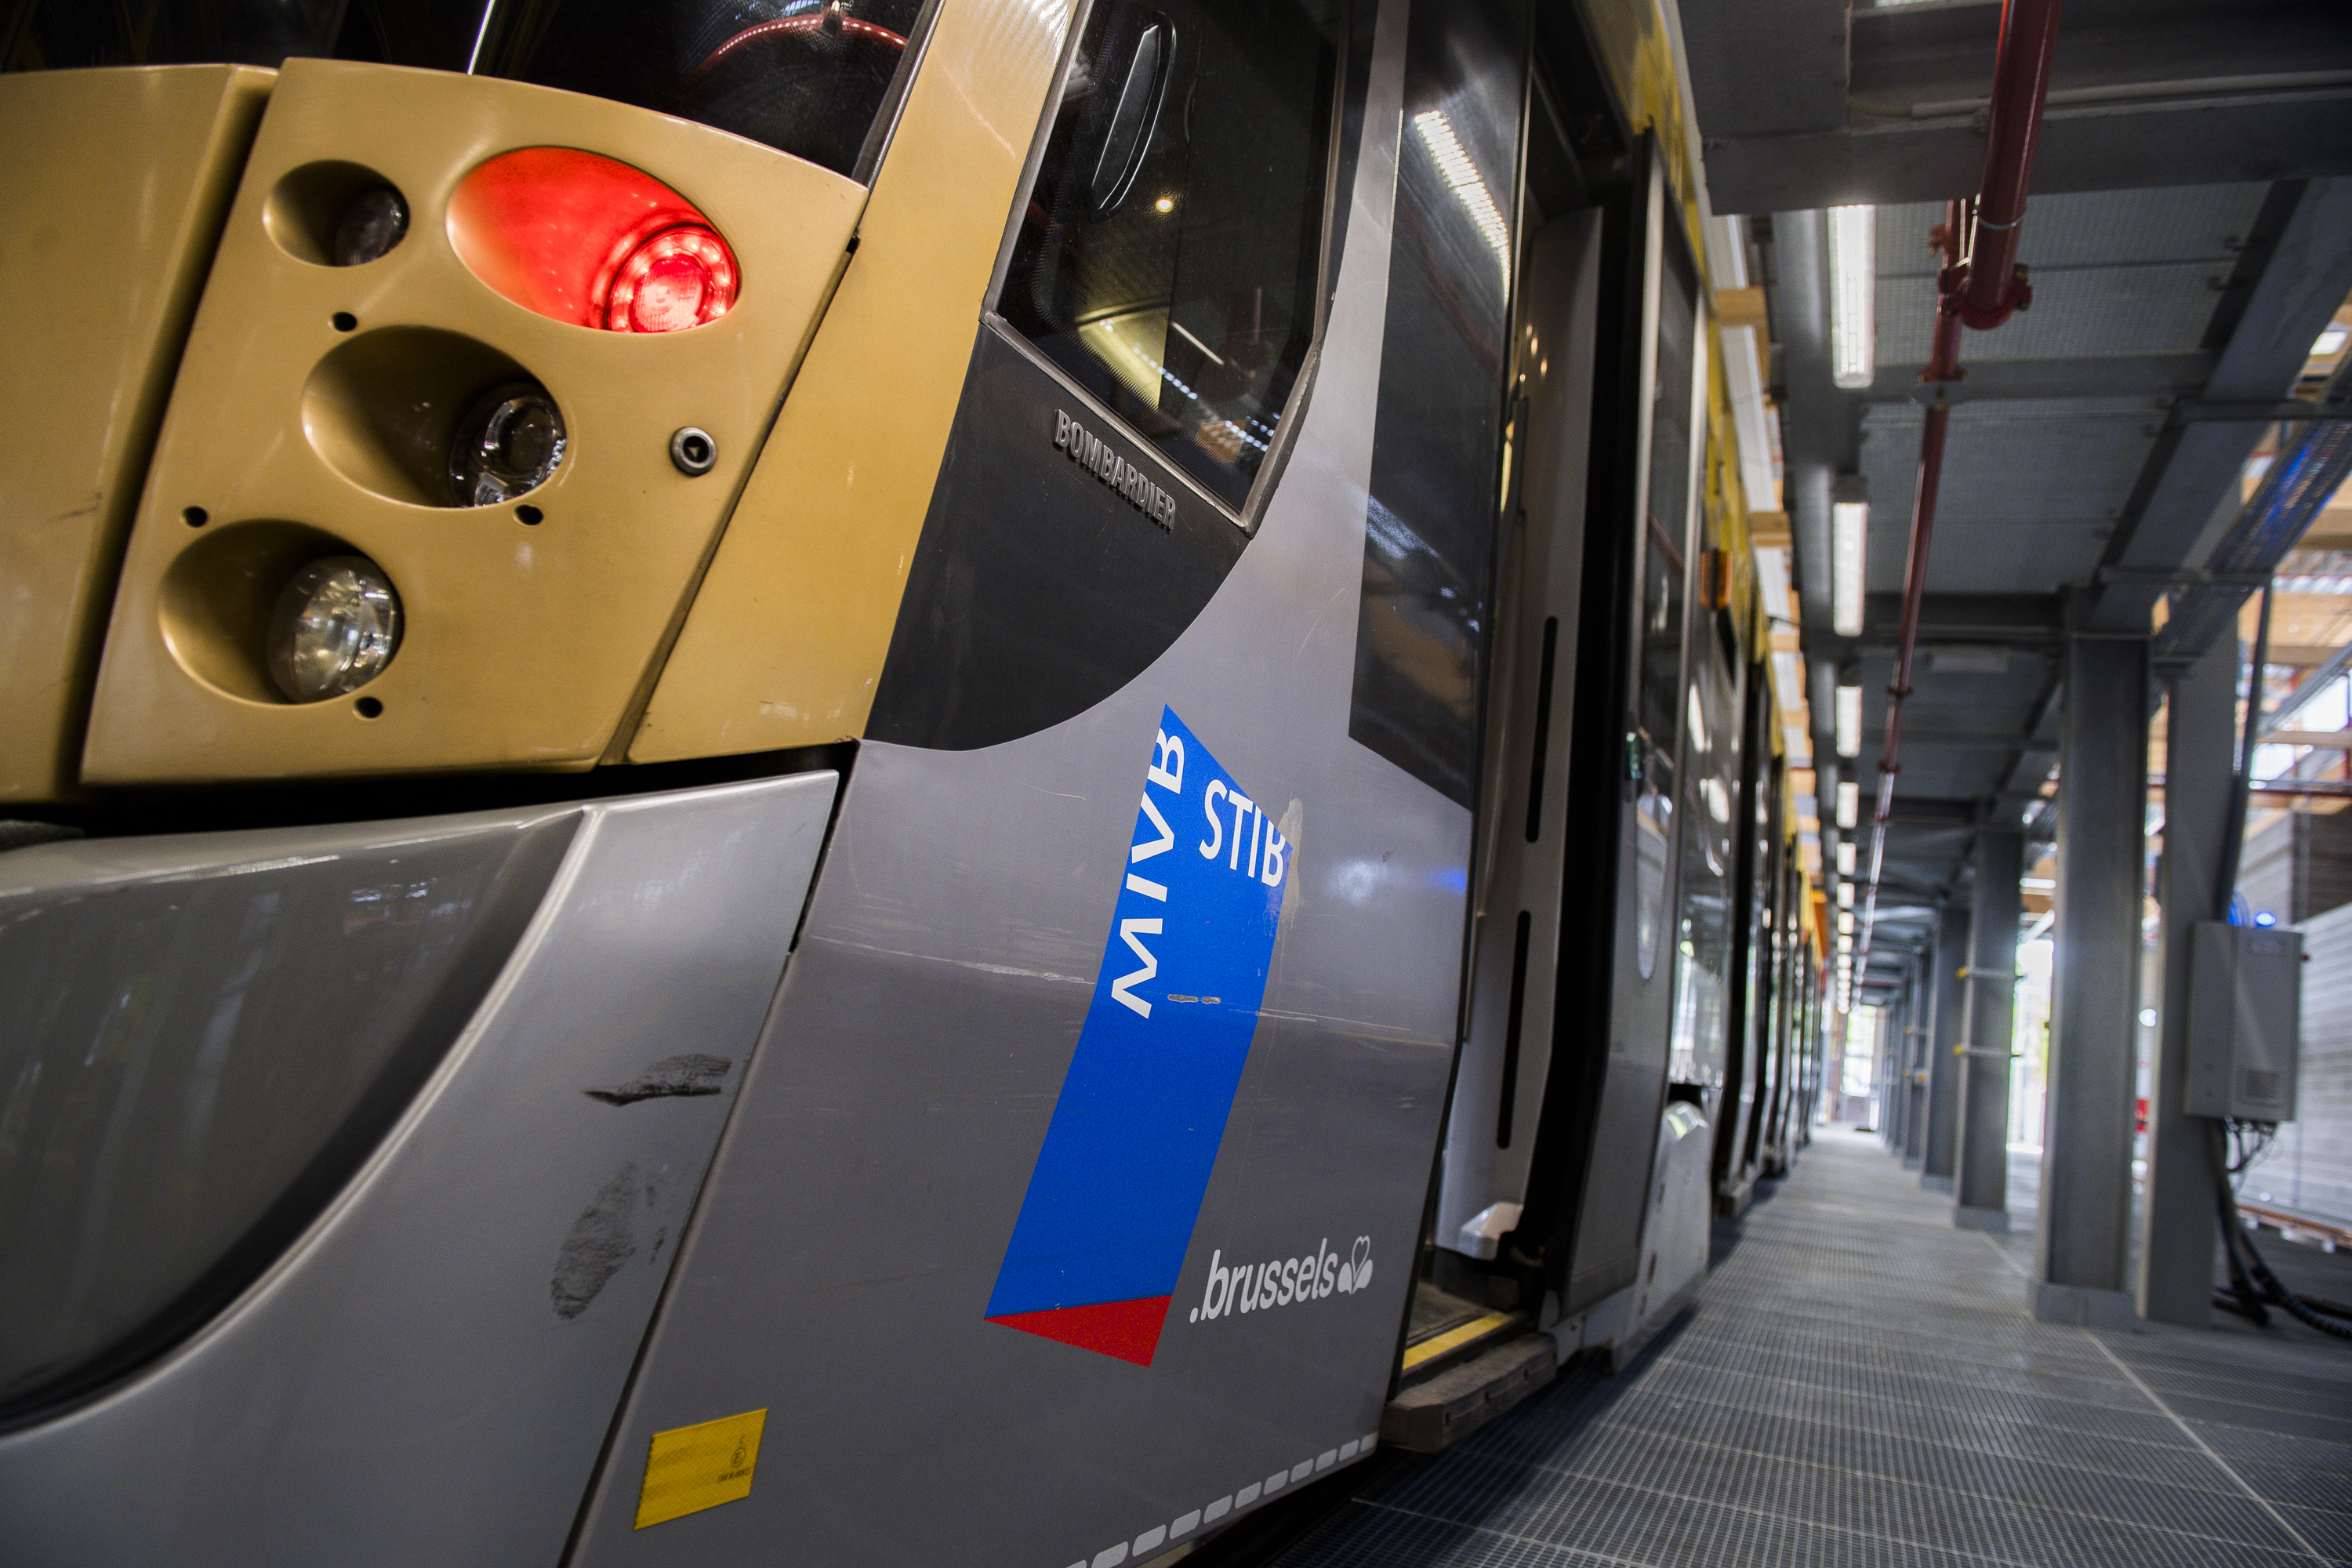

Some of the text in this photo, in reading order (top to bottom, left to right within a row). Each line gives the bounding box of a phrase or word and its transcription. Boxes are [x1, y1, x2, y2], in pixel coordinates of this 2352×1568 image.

[1053, 408, 1176, 531] BOMBARDIER
[1111, 728, 1185, 1019] MIVB
[1199, 779, 1286, 887] STIB
[1189, 1237, 1338, 1323] .brussels
